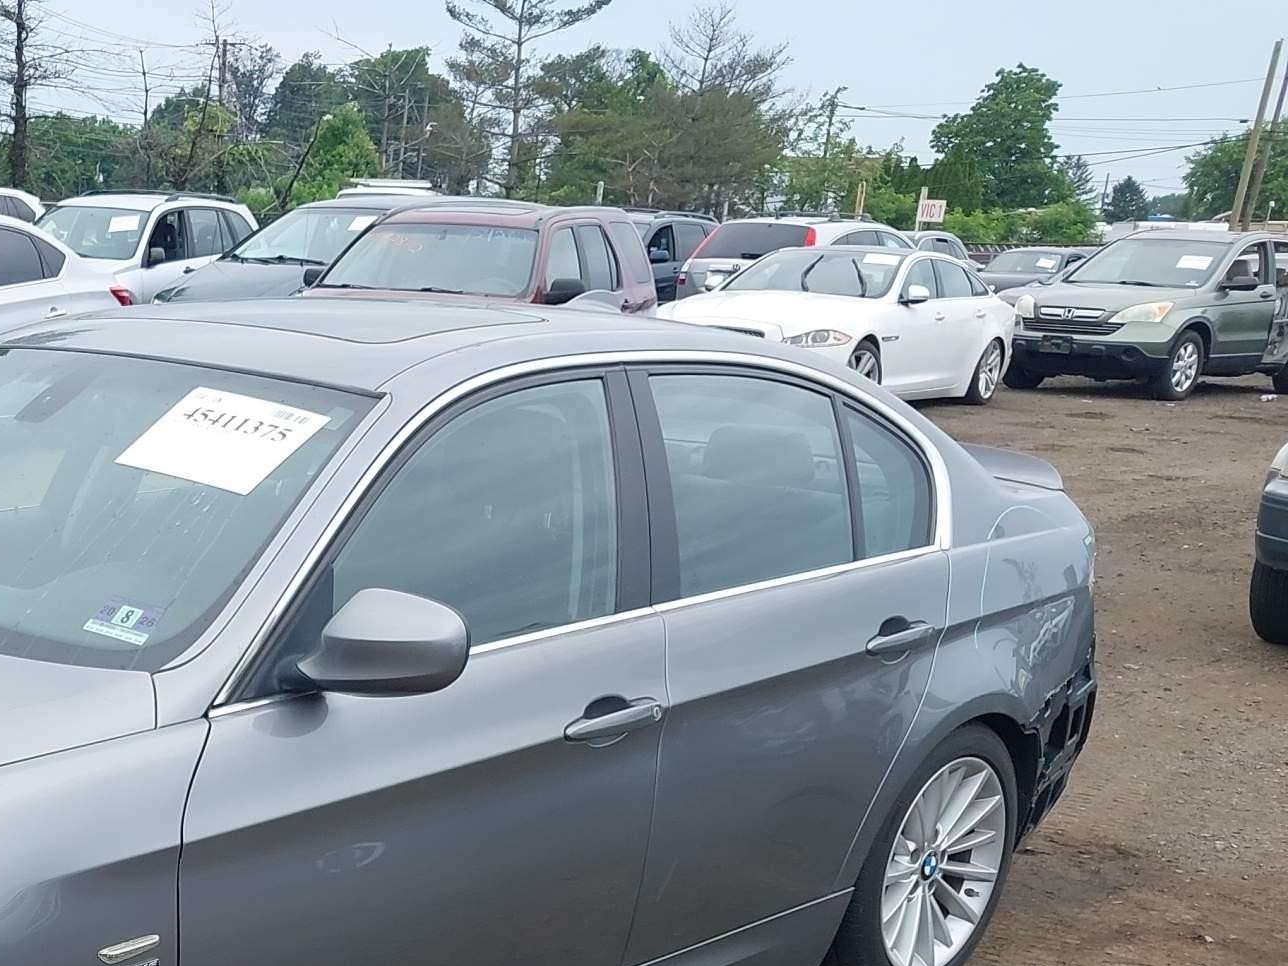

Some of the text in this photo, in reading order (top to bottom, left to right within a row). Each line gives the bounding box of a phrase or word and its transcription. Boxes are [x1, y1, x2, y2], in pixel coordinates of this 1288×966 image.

[920, 203, 936, 218] VIC
[183, 407, 294, 442] 45411375
[120, 609, 135, 624] 8
